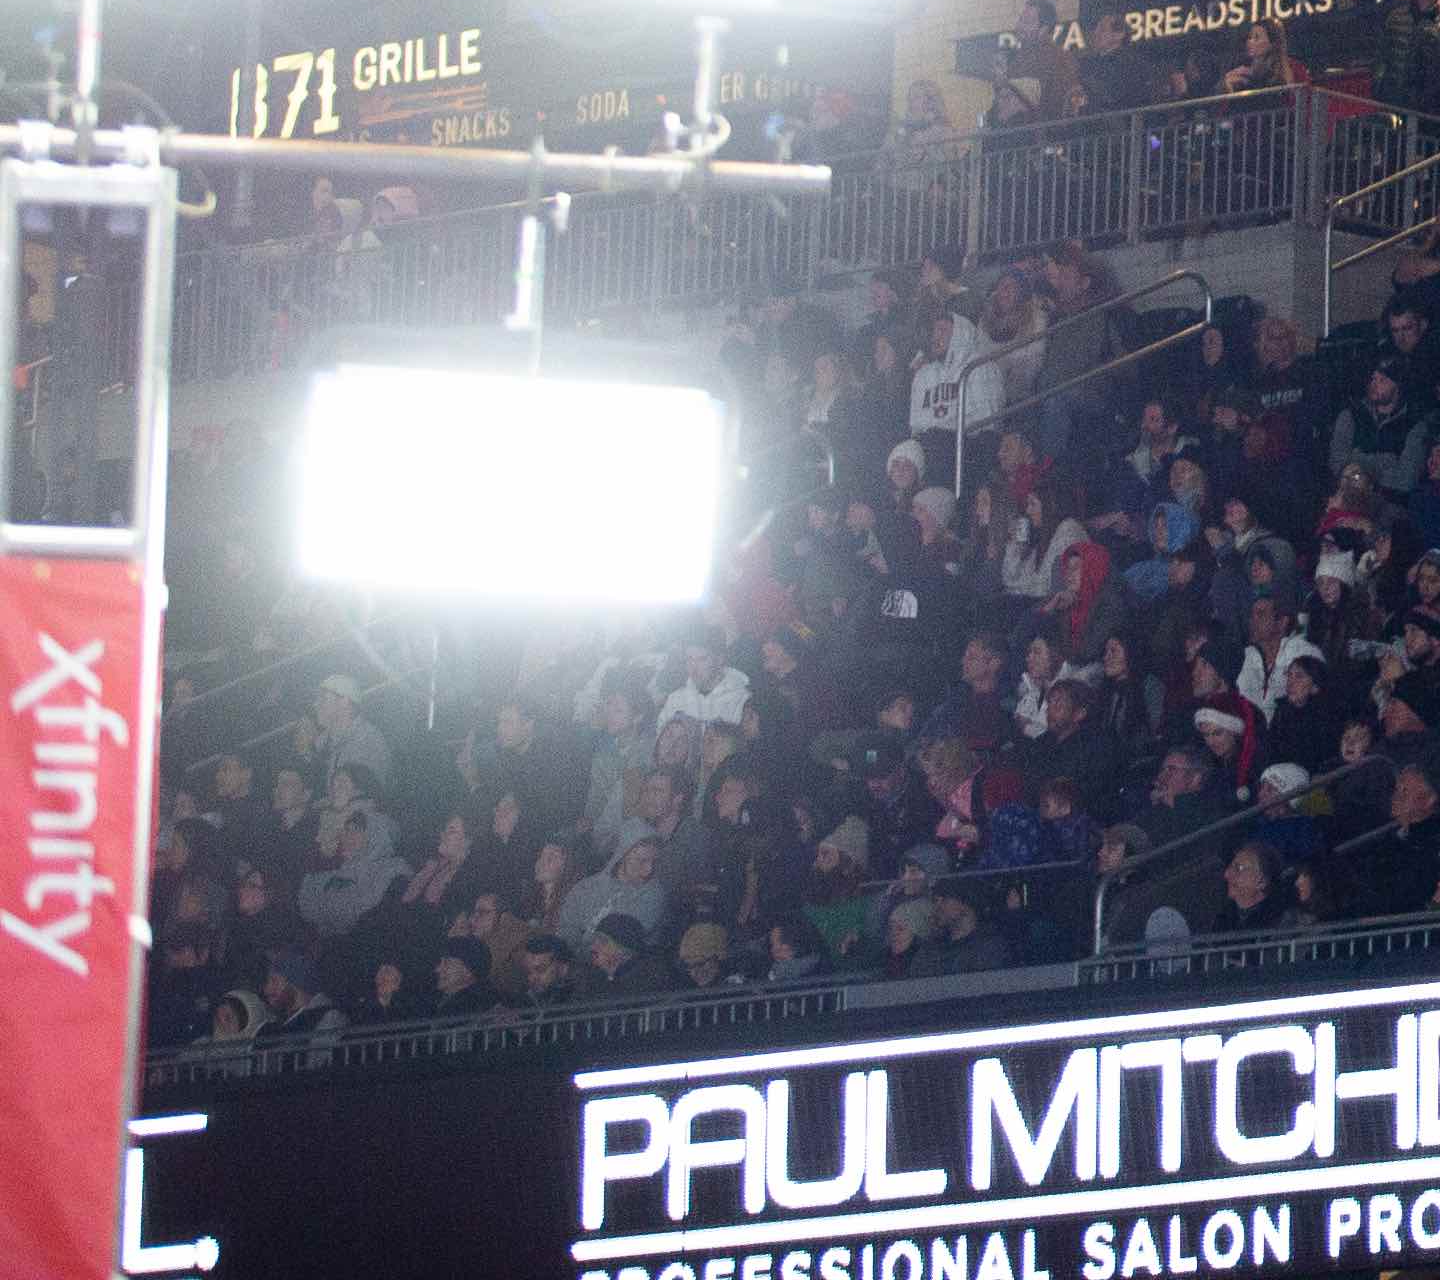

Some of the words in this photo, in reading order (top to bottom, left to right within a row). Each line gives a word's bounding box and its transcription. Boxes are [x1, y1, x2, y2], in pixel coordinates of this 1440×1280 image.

[352, 27, 482, 91] GRILLE
[431, 109, 512, 147] SNACKS
[576, 88, 631, 123] SODA
[0, 630, 129, 976] xfinity
[582, 1068, 948, 1231] PAUL
[1081, 1203, 1292, 1280] SALON
